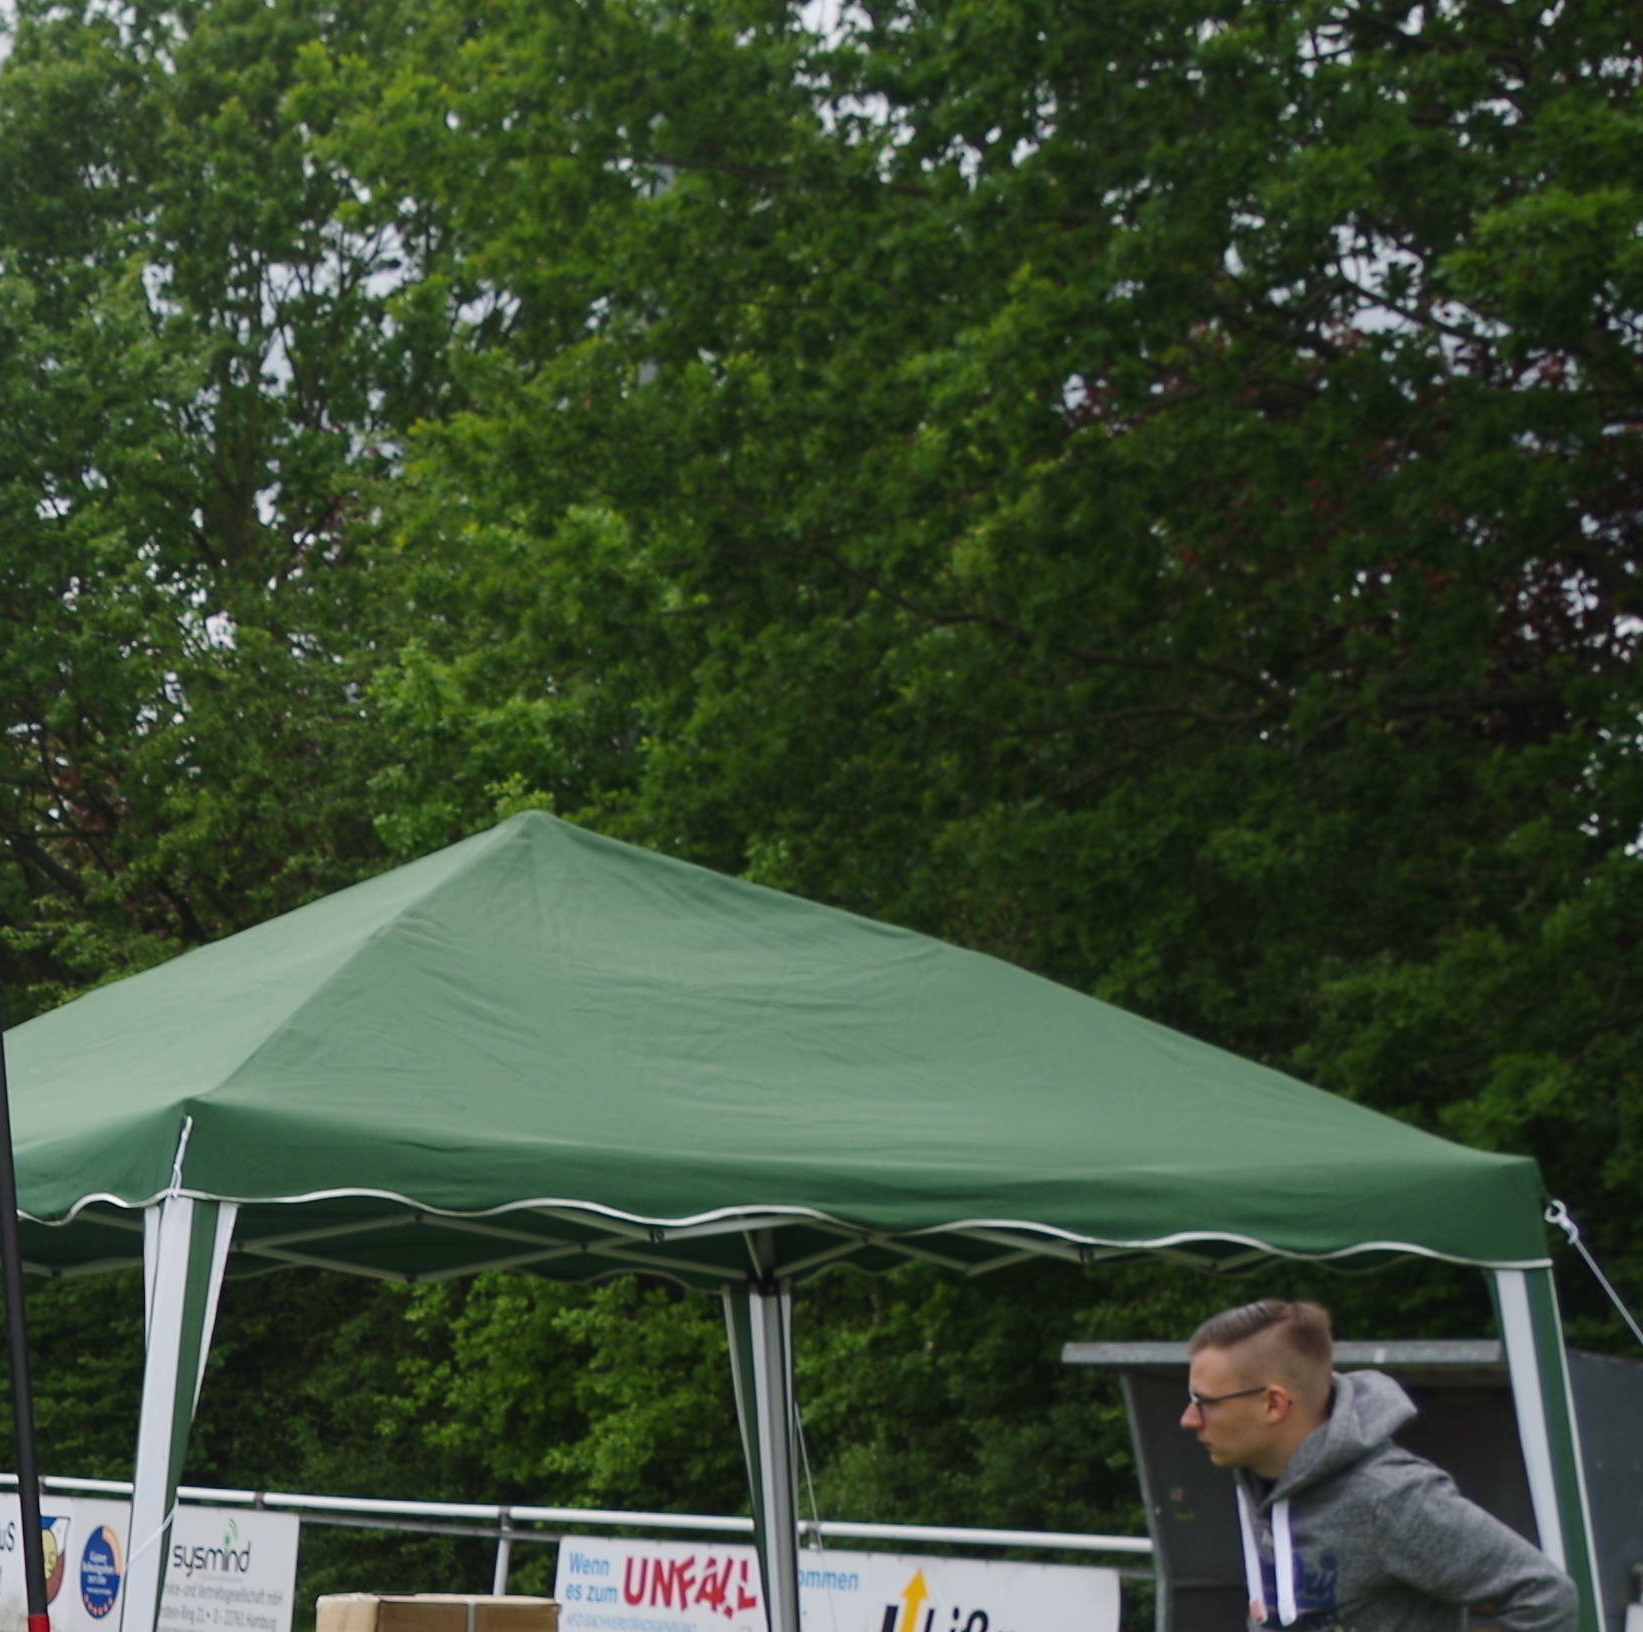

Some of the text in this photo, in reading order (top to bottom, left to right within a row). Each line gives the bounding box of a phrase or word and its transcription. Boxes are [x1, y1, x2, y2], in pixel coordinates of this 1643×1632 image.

[172, 1540, 252, 1577] sysmind
[569, 1552, 610, 1576] Wenn
[798, 1569, 860, 1591] ommen
[566, 1584, 618, 1604] es zum
